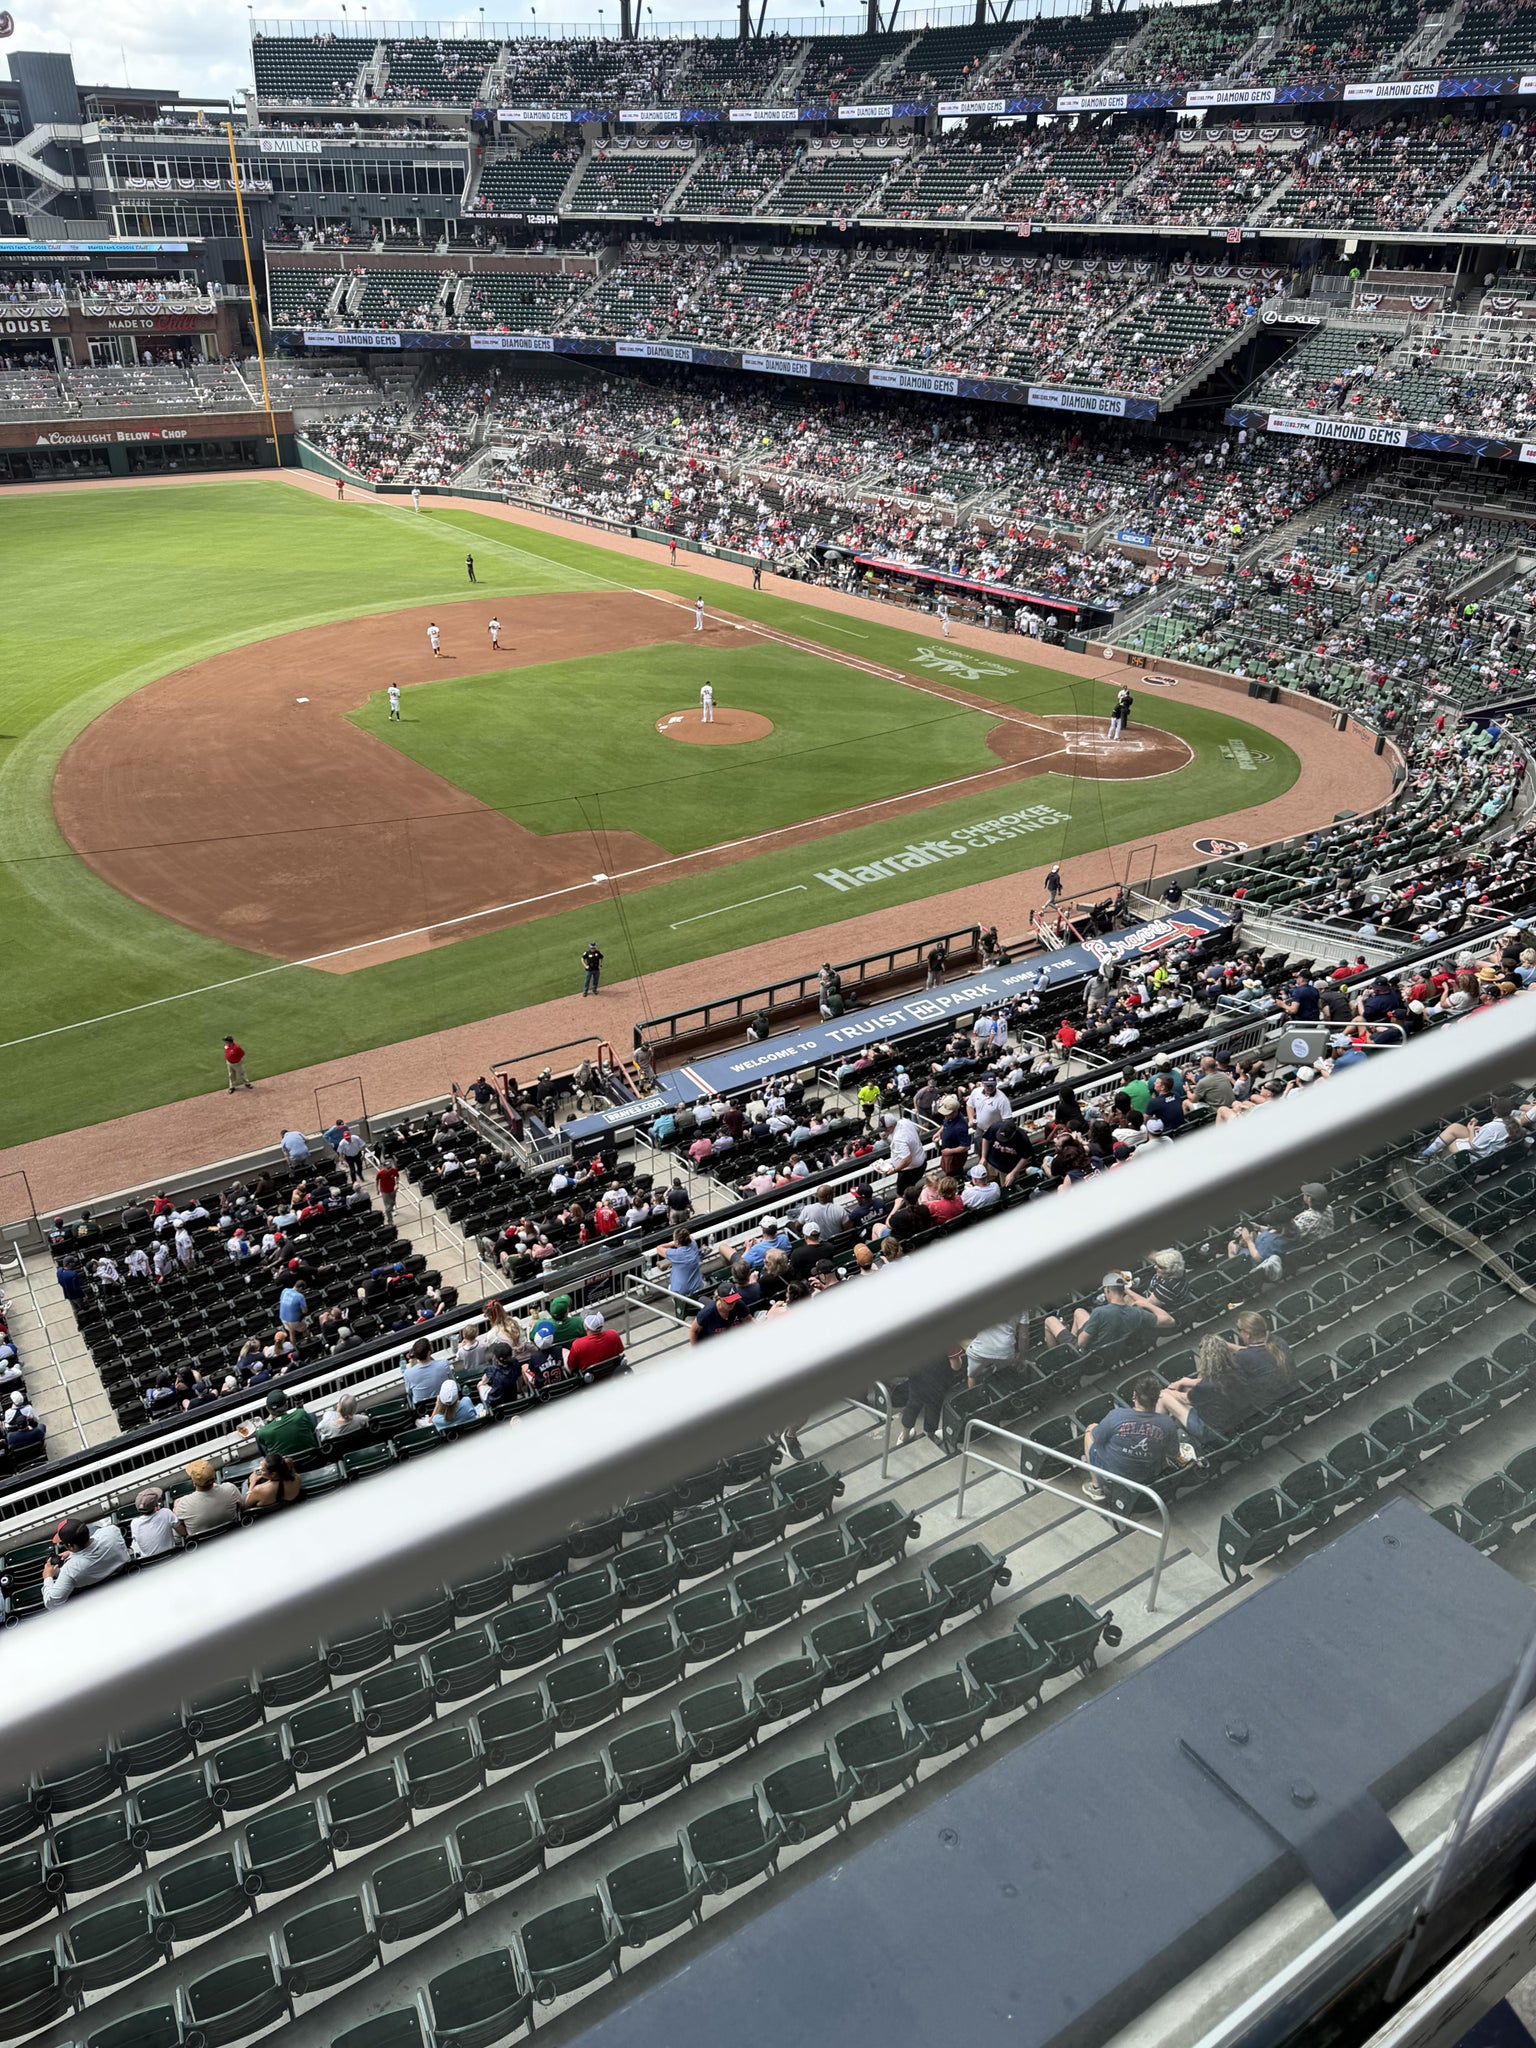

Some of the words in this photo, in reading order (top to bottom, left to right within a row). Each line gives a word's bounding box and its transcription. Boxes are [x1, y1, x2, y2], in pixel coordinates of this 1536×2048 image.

[1217, 92, 1249, 103] DIAMOND
[1251, 90, 1271, 101] GEMS
[1376, 84, 1411, 97] DIAMOND
[1412, 83, 1435, 95] GEMS
[961, 103, 985, 112] DIAMOND
[986, 102, 1003, 111] GEMS
[1081, 98, 1107, 107] DIAMOND
[1108, 97, 1124, 106] GEMS
[274, 140, 320, 152] MILNER
[546, 215, 559, 224] PM
[1227, 227, 1241, 243] 21
[108, 320, 138, 329] MADE
[140, 319, 154, 328] TO
[1278, 314, 1321, 325] LEXUS
[338, 335, 374, 345] DIAMOND
[375, 336, 397, 345] GEMS
[501, 339, 532, 348] DIAMOND
[533, 340, 551, 349] GEMS
[646, 346, 673, 357] DIAMOND
[674, 349, 690, 360] GEMS
[765, 360, 791, 372] DIAMOND
[792, 363, 808, 374] GEMS
[899, 375, 932, 390] DIAMOND
[933, 380, 954, 392] GEMS
[1061, 395, 1097, 410] DIAMOND
[1098, 399, 1121, 413] GEMS
[48, 432, 82, 445] Coors
[82, 434, 112, 443] LIGHT
[116, 431, 151, 442] BELOW
[161, 429, 188, 439] CHOP
[1315, 421, 1366, 440] DIAMOND
[1368, 428, 1402, 444] GEMS
[1121, 534, 1146, 544] GEICO
[951, 804, 1057, 840] CHEROKEE
[968, 812, 1072, 848] CASINOS
[812, 840, 968, 892] Harrah's
[1082, 919, 1174, 962] Braves
[730, 1047, 798, 1073] WELCOME
[797, 1041, 817, 1051] TO
[825, 1010, 908, 1042] TRUIST
[936, 983, 998, 1009] PARK
[1001, 970, 1038, 986] HOME
[1051, 958, 1077, 970] THE
[607, 1099, 663, 1121] BRAVES.COM
[543, 1368, 562, 1386] 13
